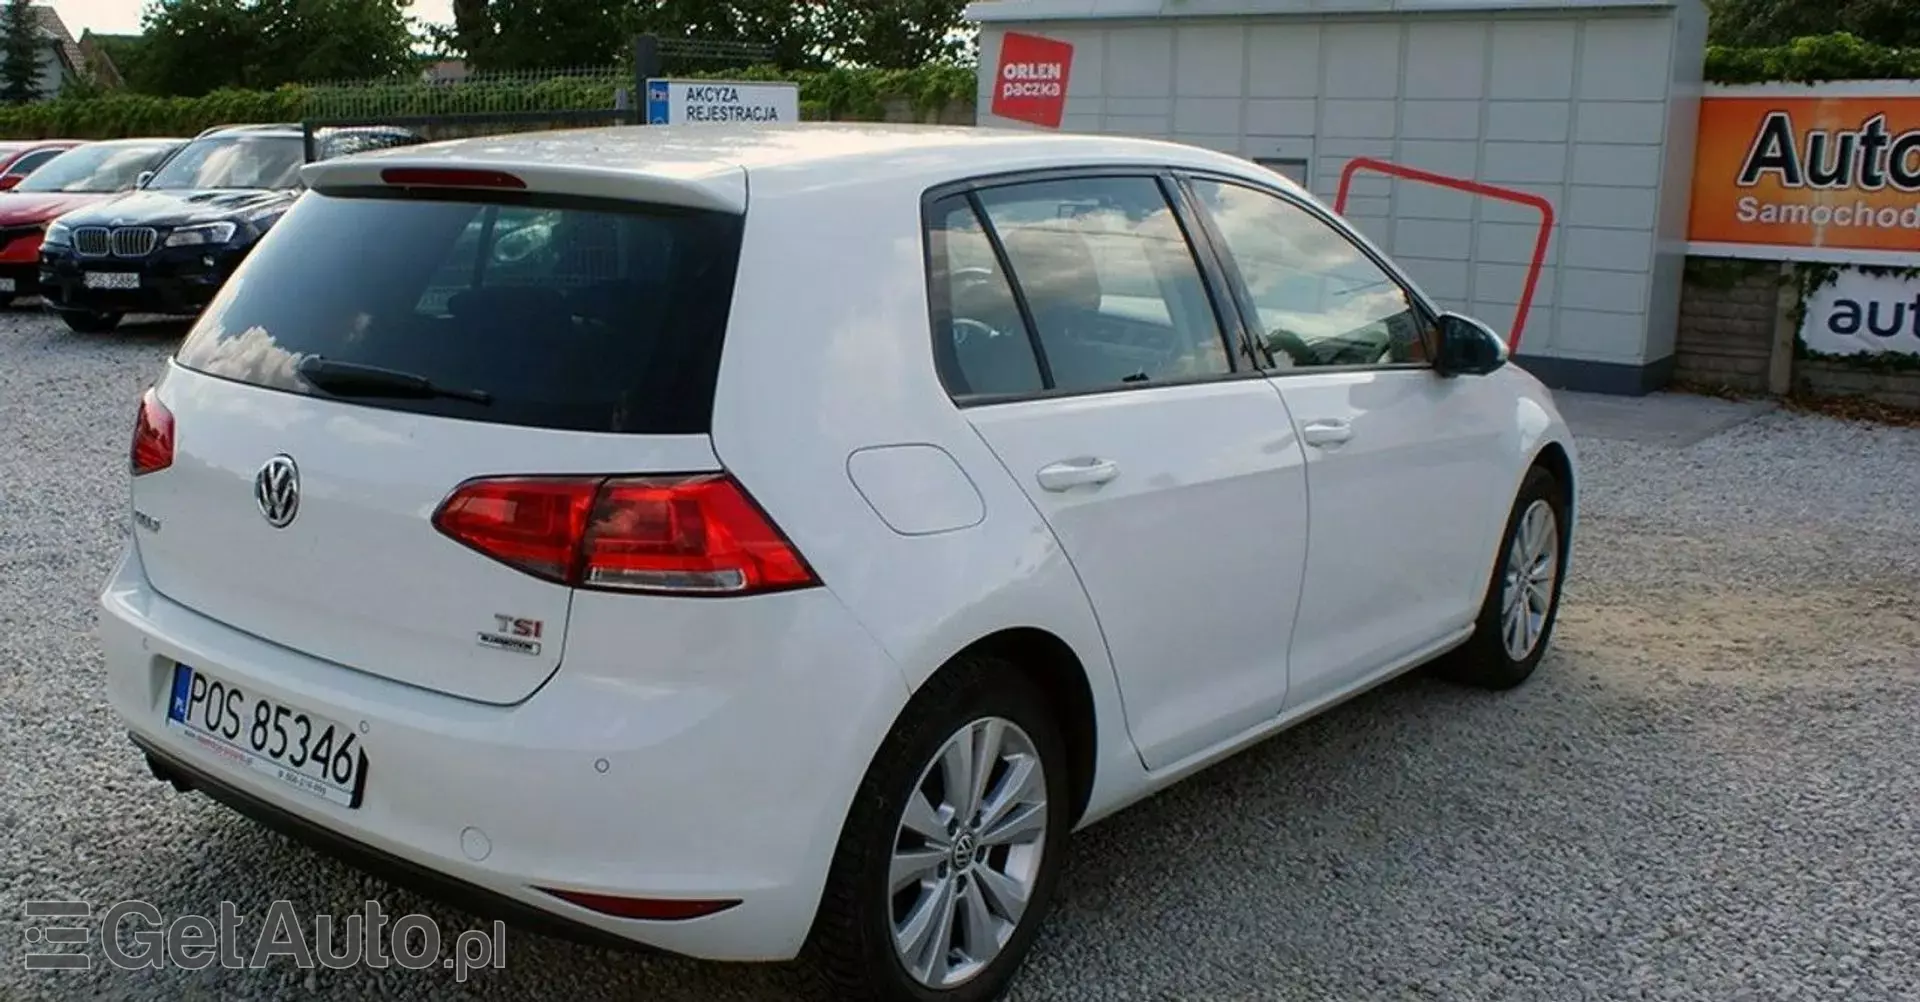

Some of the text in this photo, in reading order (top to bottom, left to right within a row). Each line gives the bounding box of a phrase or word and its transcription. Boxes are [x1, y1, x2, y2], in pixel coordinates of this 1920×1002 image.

[1003, 63, 1061, 80] ORLEN
[686, 87, 739, 103] AKCYZA
[1003, 82, 1061, 100] paczka
[686, 105, 779, 122] REJESTRACJA
[1737, 112, 1920, 191] Auto
[1736, 196, 1920, 229] Samochod
[494, 613, 543, 638] TSI
[187, 672, 244, 740] POS
[251, 700, 357, 784] 85346
